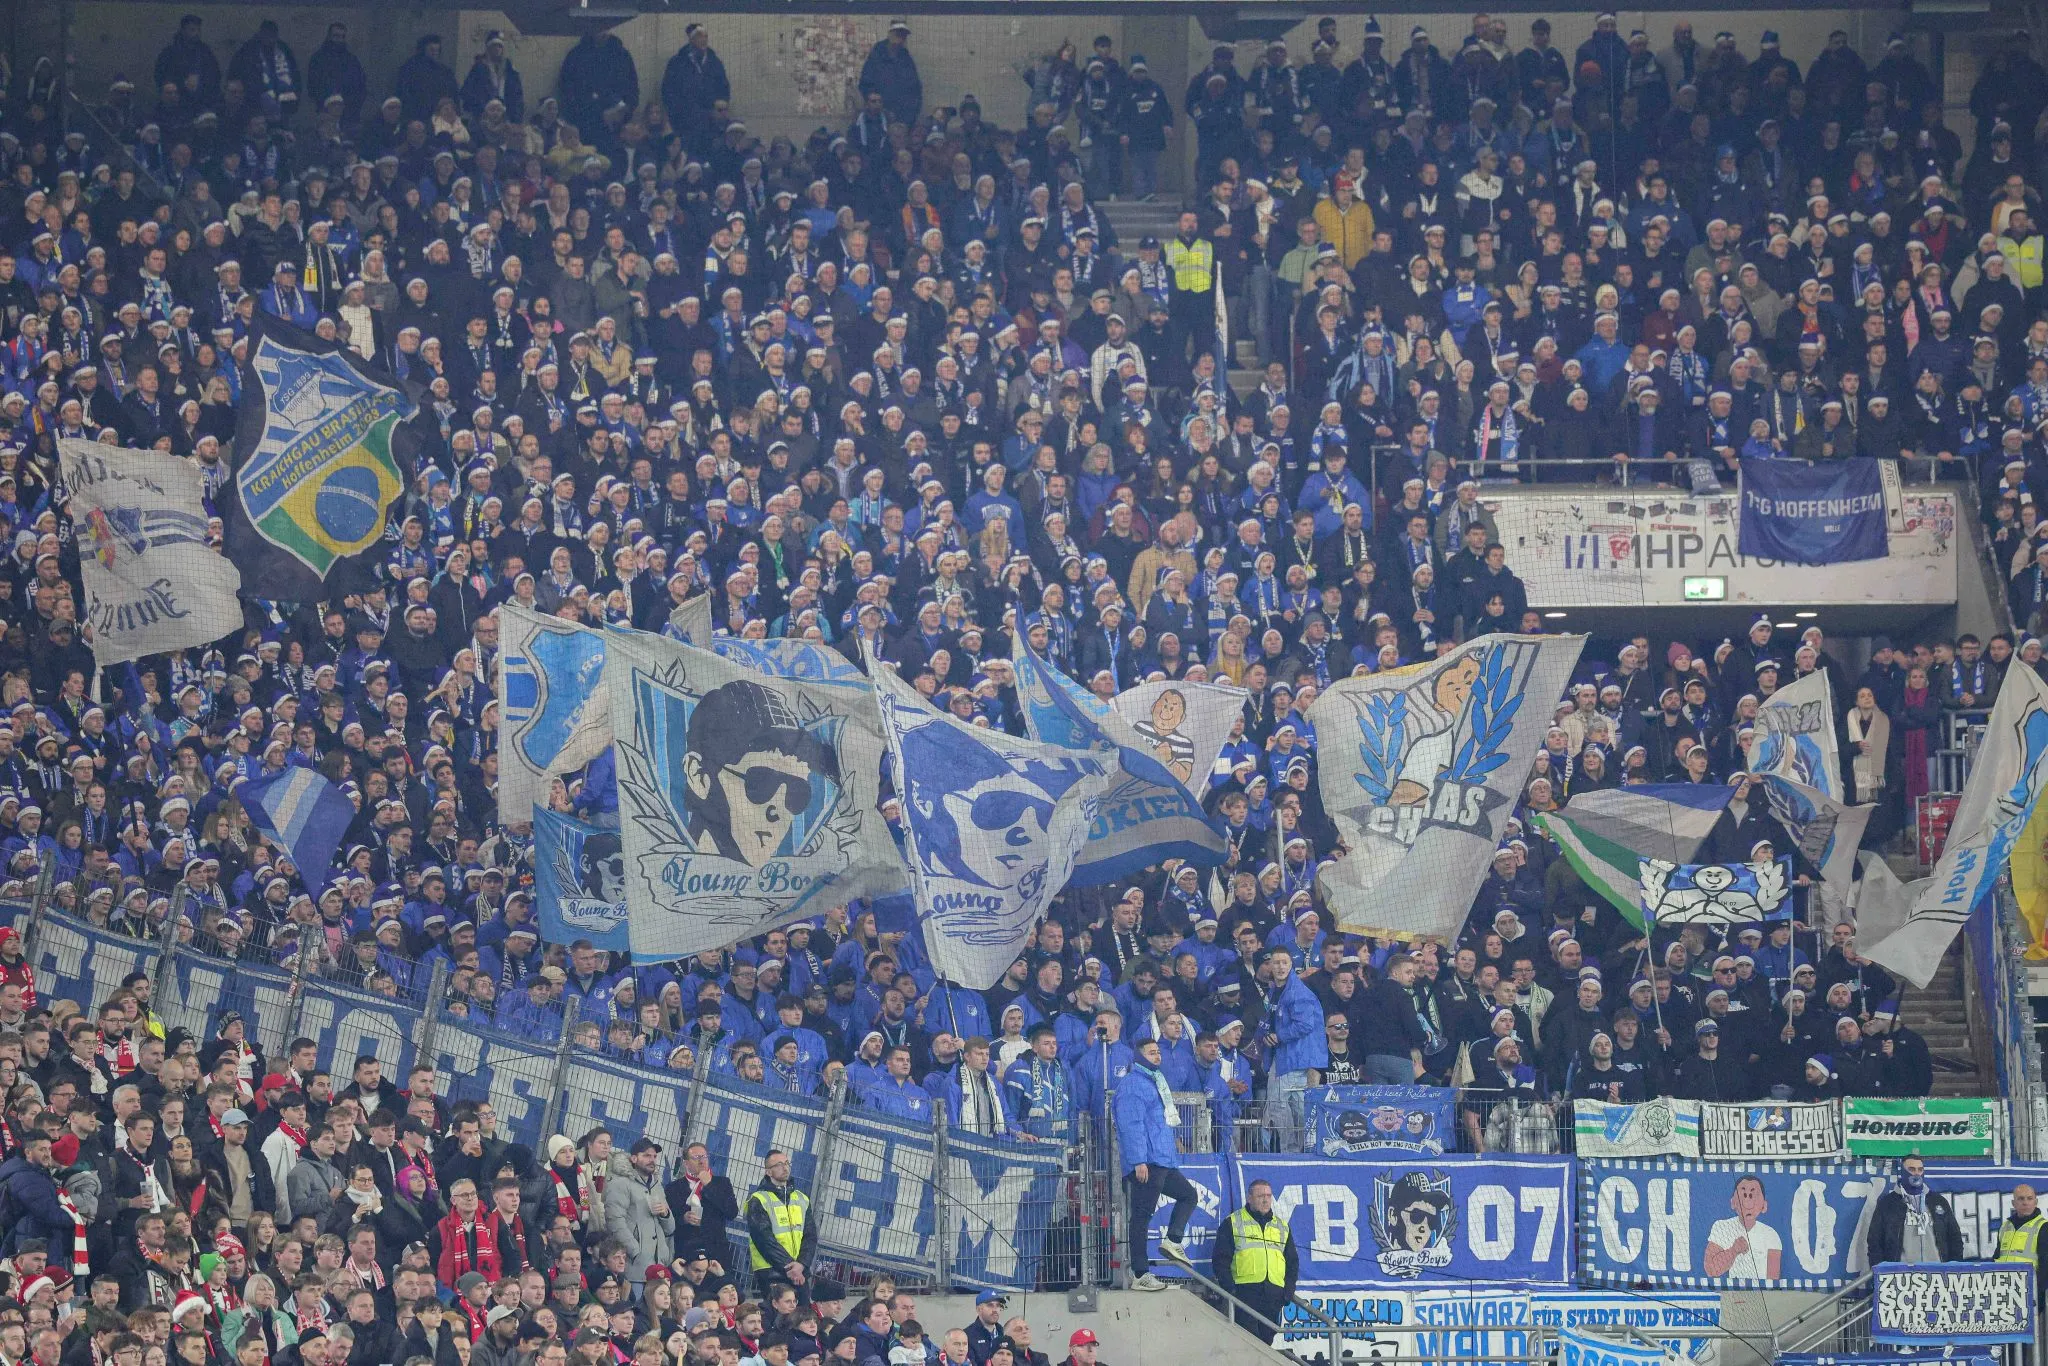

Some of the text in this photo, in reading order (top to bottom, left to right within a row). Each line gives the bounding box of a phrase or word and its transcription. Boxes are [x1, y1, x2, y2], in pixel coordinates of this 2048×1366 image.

[251, 434, 321, 496] KRAICHGAU
[1747, 490, 1883, 518] TG HOFFENHEIM
[662, 853, 751, 897] Young
[568, 900, 611, 918] Young
[932, 892, 1004, 914] oung
[1851, 1119, 1969, 1136] HOMBURG
[1703, 1127, 1838, 1154] UNVERGESSEN
[1467, 1184, 1561, 1262] 07
[1599, 1175, 1887, 1274] CH 07
[1878, 1271, 2028, 1293] ZUSAMMEN
[1878, 1289, 2028, 1312] SCHAFFEN
[1415, 1301, 1528, 1327] SCHWARZ
[1532, 1304, 1721, 1328] FÜR STADT UND VEREIN
[1878, 1304, 1927, 1328] WIR
[1284, 1321, 1376, 1342] HOFFEHEIM
